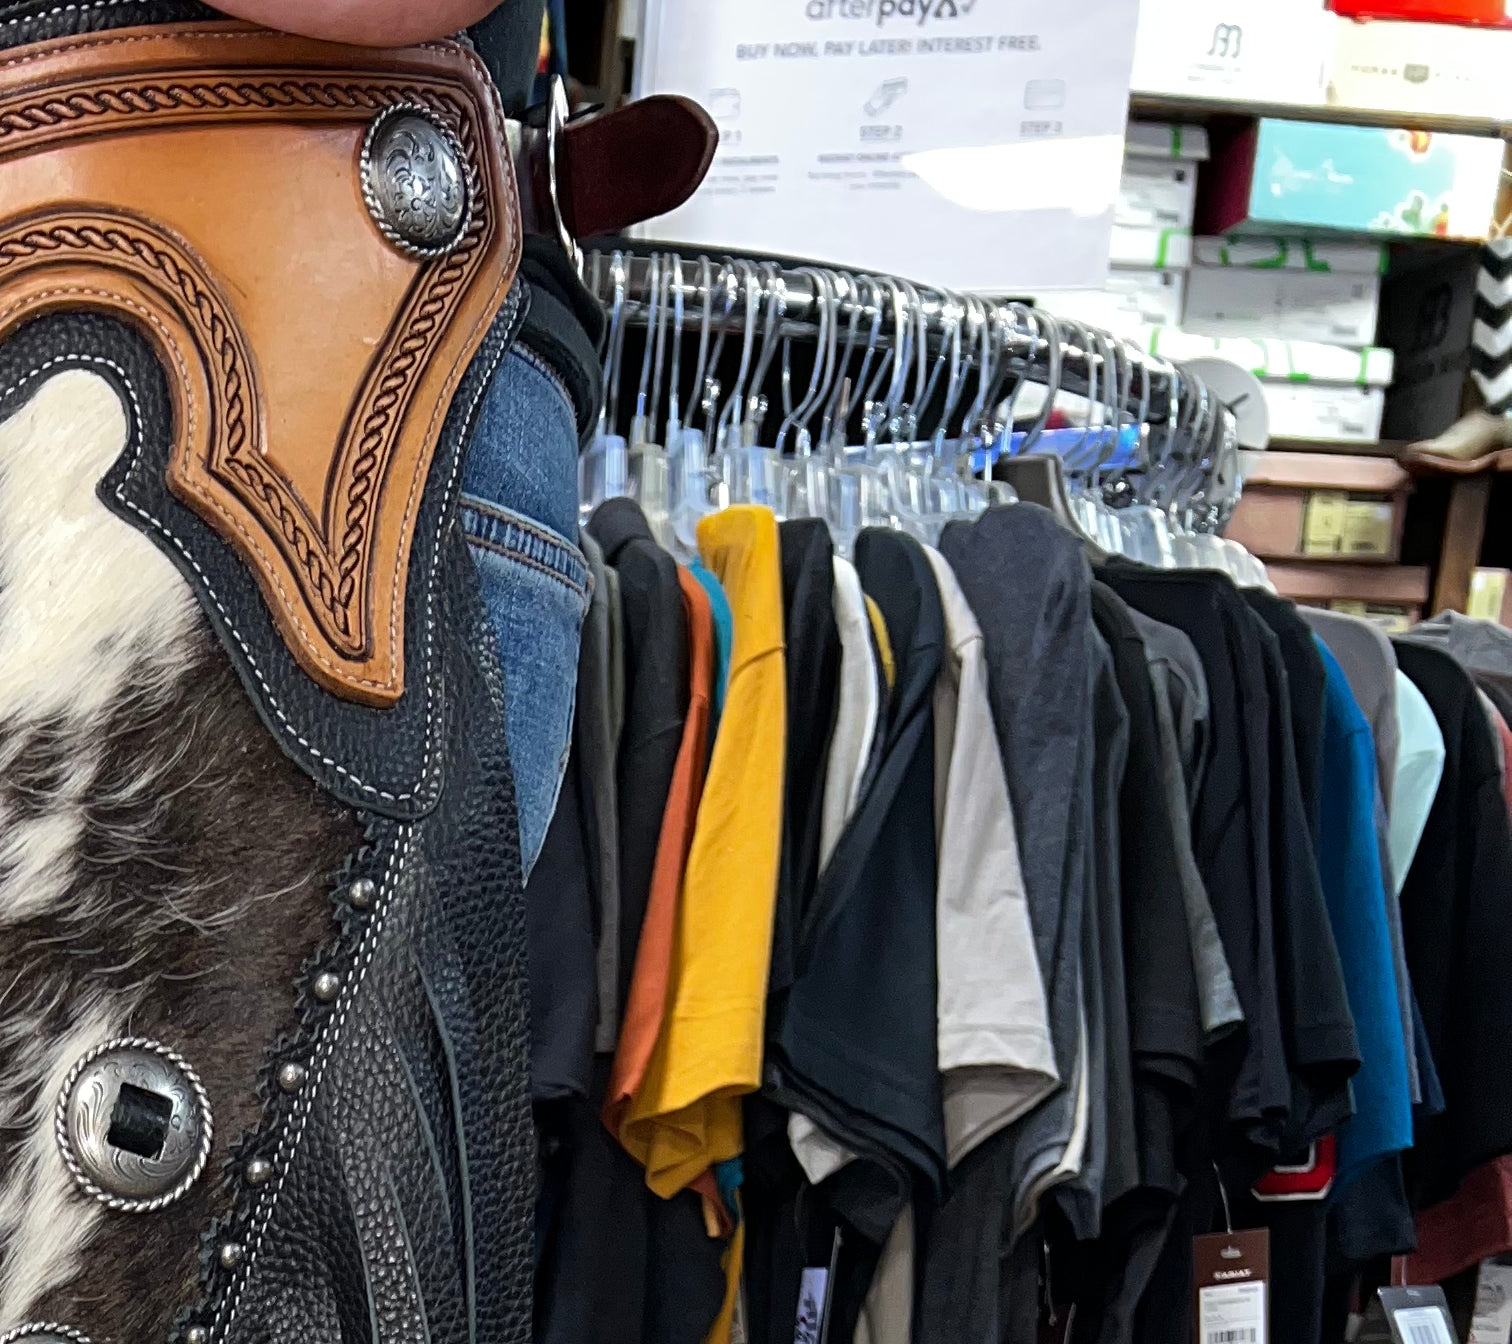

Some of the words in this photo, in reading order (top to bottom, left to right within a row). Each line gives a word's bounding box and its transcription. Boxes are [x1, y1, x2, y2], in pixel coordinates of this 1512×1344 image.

[736, 42, 769, 60] BUY
[824, 39, 856, 57] PAY
[916, 35, 993, 54] INTEREST
[860, 125, 891, 141] STEP
[894, 125, 903, 139] 2
[1020, 120, 1050, 137] STEP
